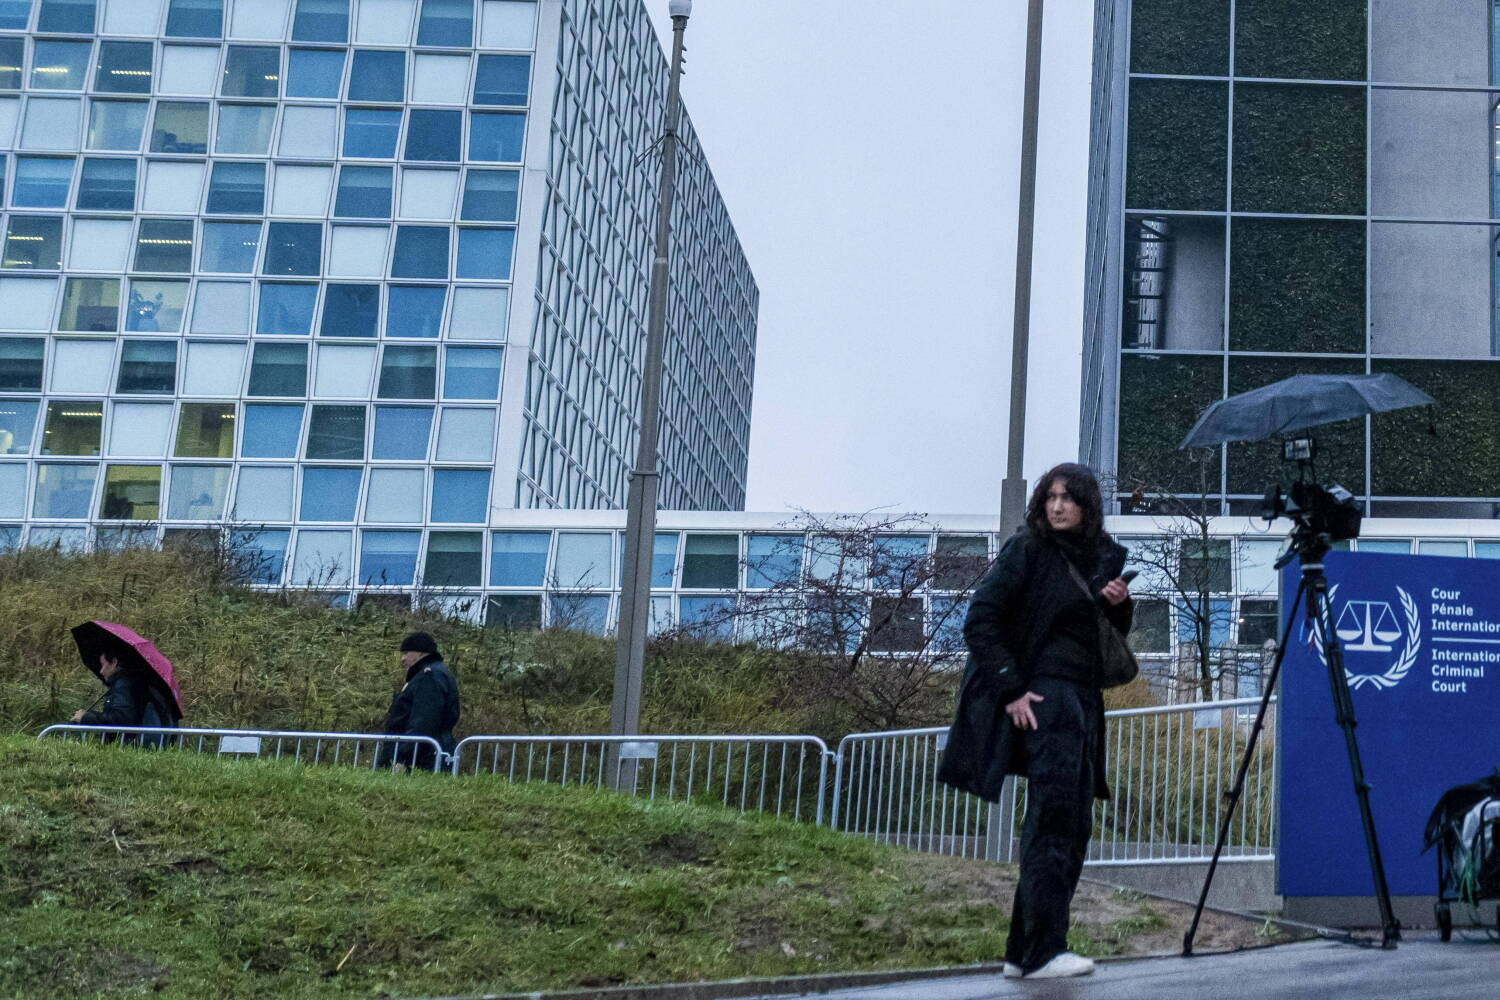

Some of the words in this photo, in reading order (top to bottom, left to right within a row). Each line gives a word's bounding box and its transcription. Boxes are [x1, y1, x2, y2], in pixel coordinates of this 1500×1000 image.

[1431, 587, 1460, 600] Cour
[1432, 602, 1473, 616] Pénale
[1432, 664, 1484, 678] Criminal
[1432, 680, 1467, 693] Court
